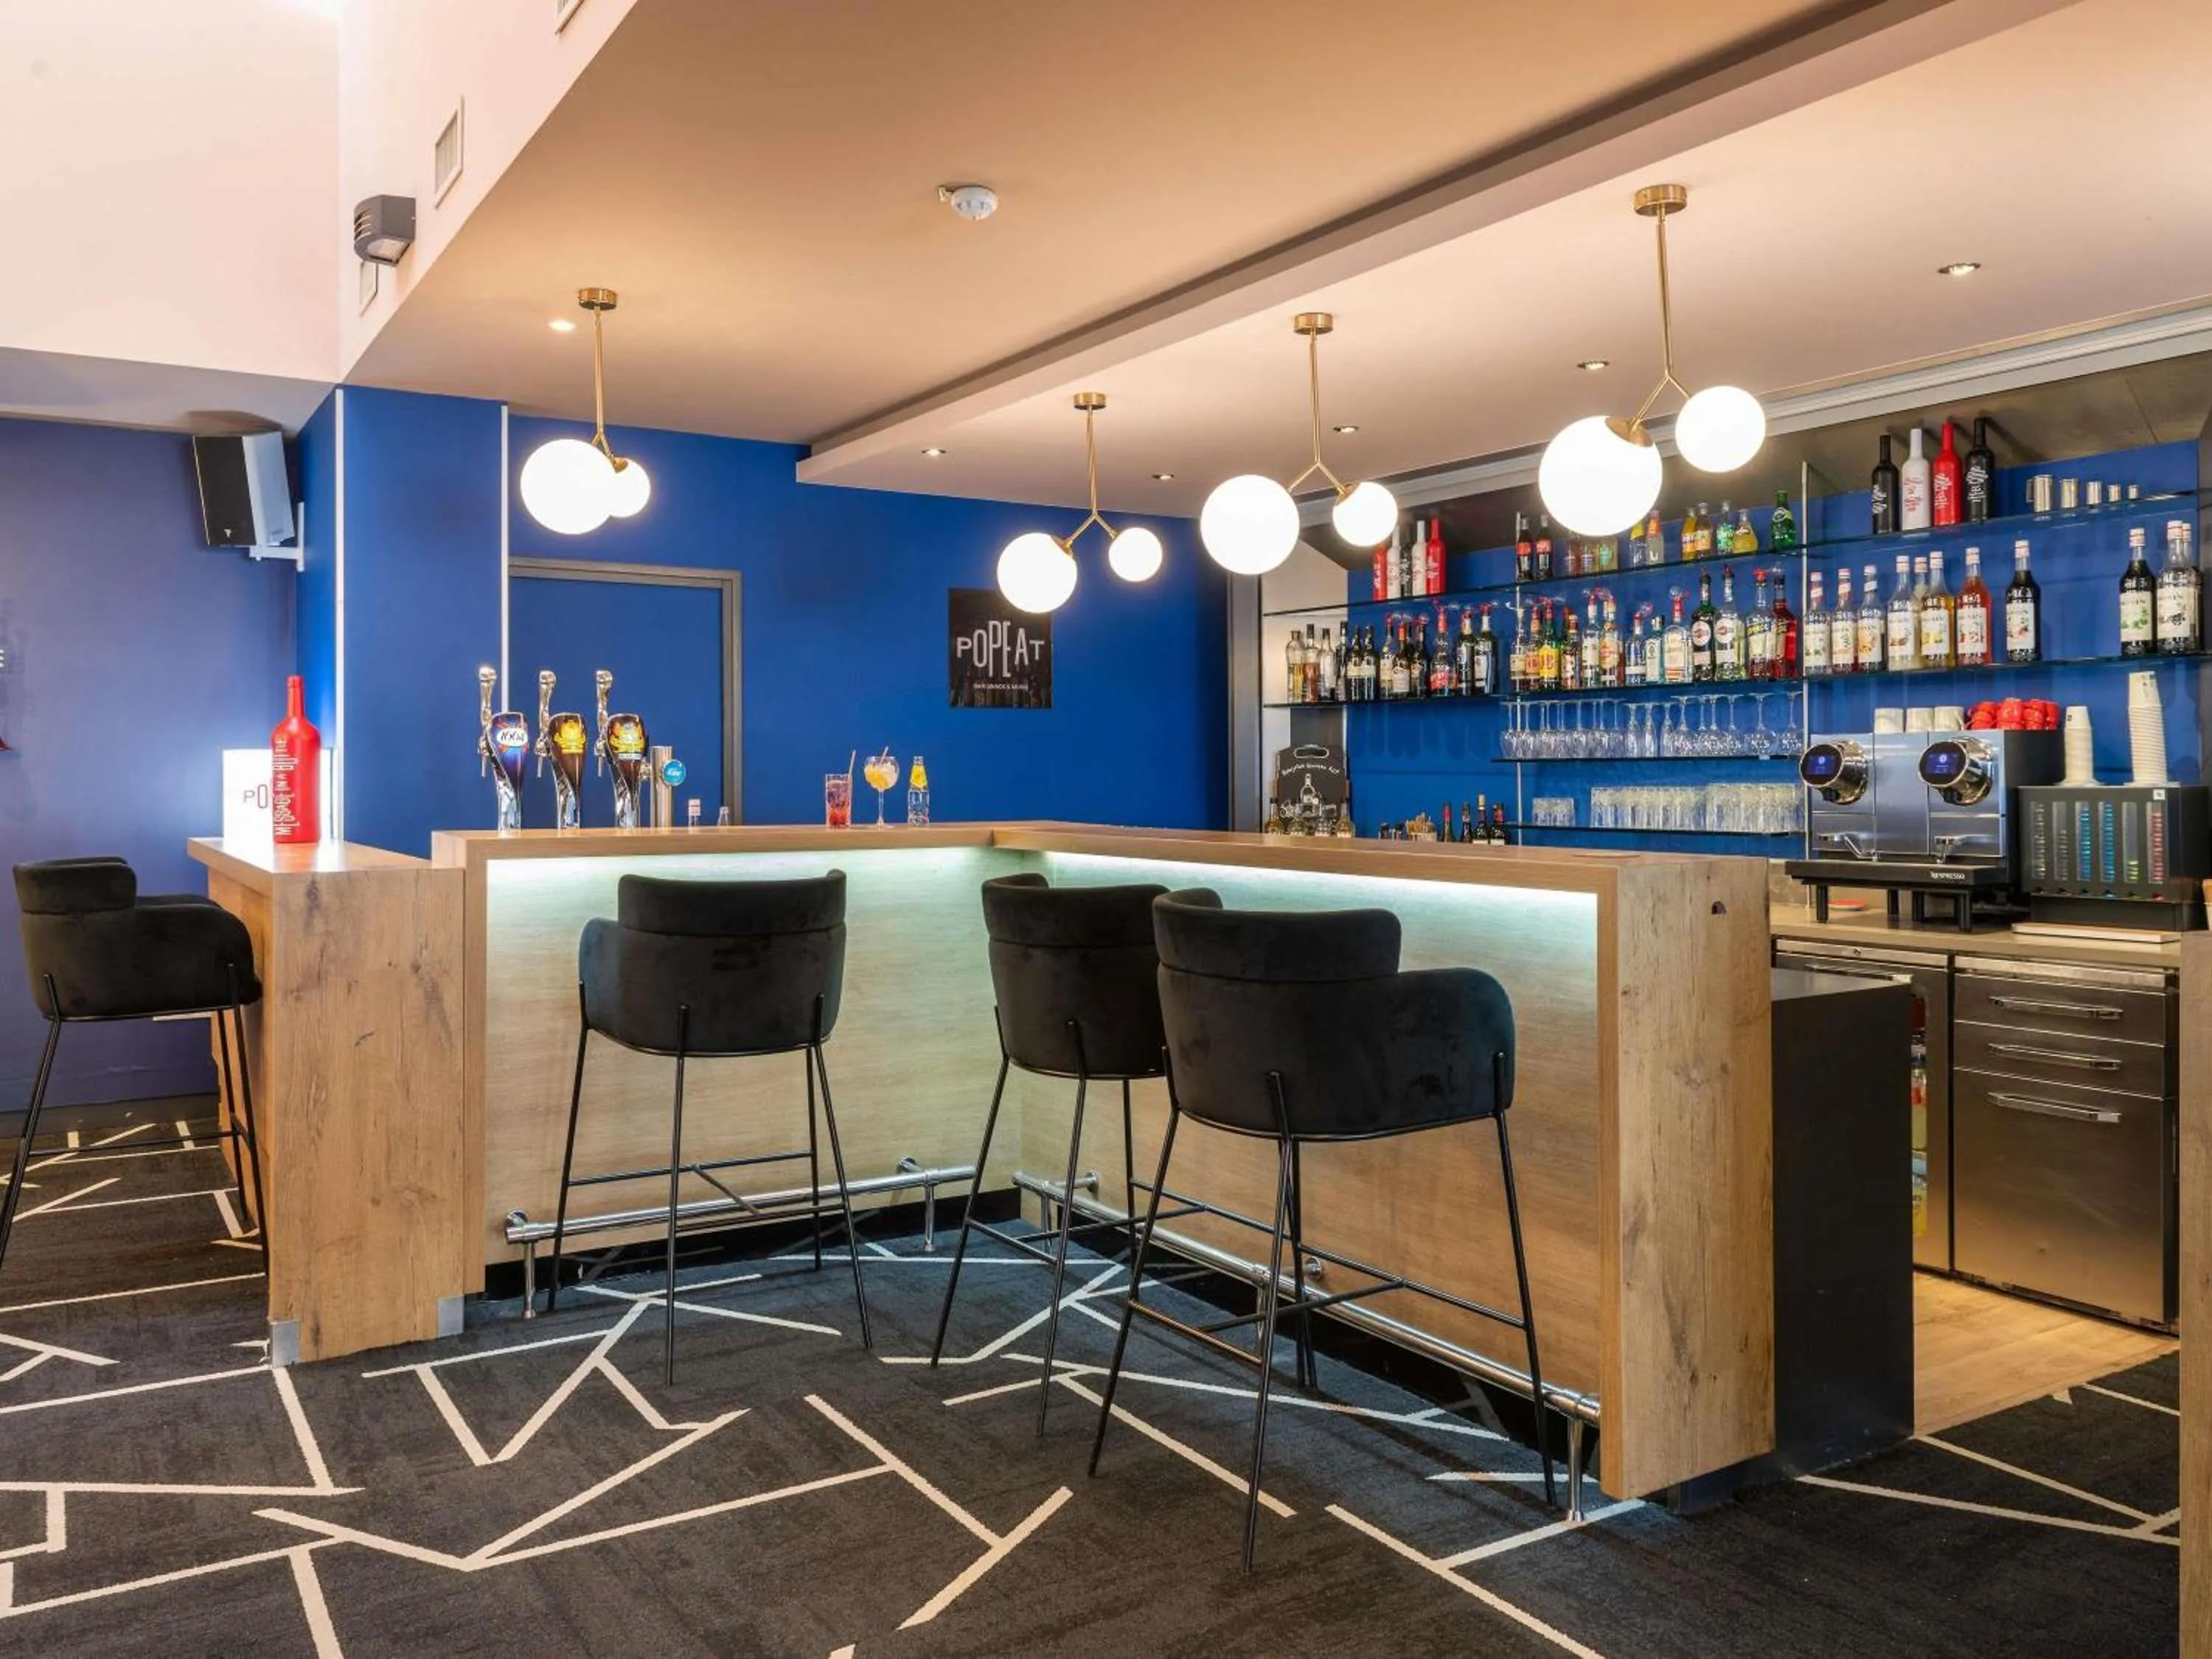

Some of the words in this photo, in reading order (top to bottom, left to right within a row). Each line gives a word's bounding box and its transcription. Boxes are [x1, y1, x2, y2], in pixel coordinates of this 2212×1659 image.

[956, 620, 1045, 678] POPEAT
[243, 779, 273, 809] PO
[272, 793, 300, 836] MESSAGE
